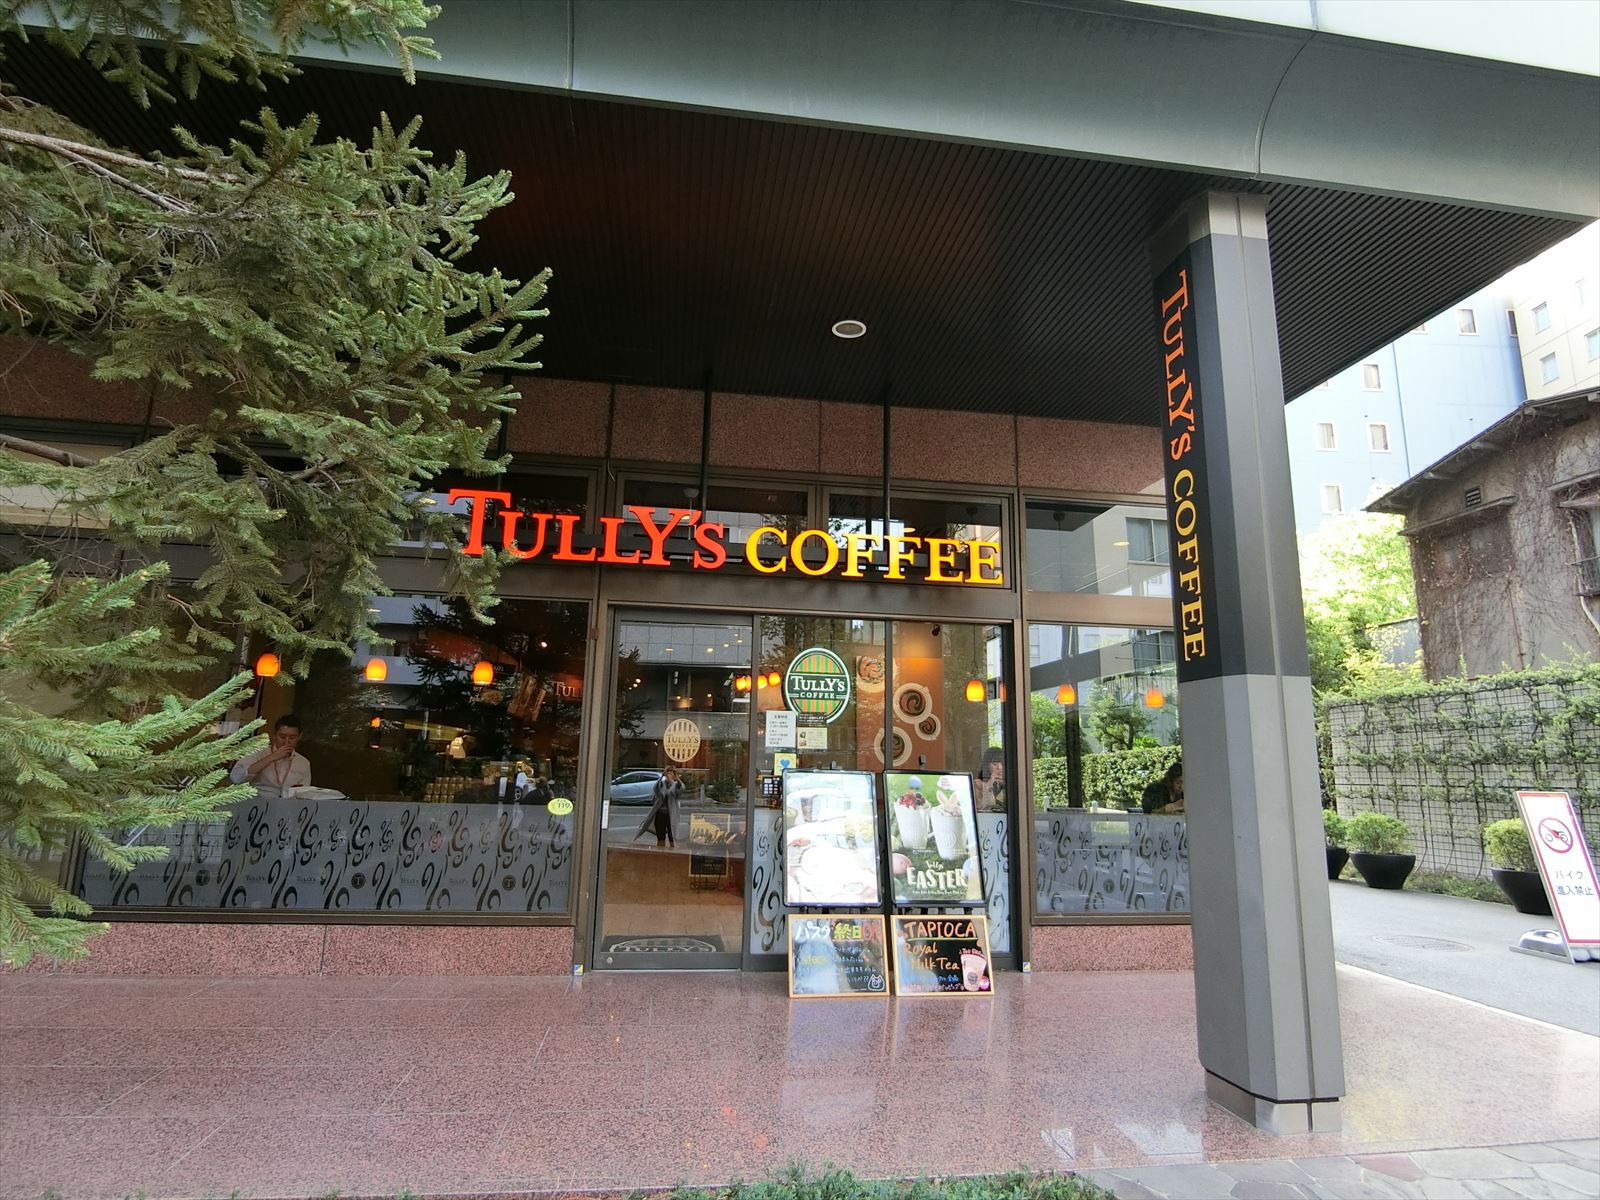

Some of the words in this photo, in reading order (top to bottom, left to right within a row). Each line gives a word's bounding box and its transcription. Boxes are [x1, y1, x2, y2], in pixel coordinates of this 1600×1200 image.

[1161, 269, 1195, 461] TULLY'S
[448, 487, 727, 569] TULLY'S
[745, 526, 1005, 585] COFFEE
[1172, 468, 1207, 662] COFFEE
[790, 675, 846, 692] TULLY'S
[906, 867, 969, 890] EASTER
[1555, 869, 1584, 880] バイク
[1556, 885, 1595, 896] 進入禁止
[903, 920, 977, 938] TAPIOCA
[902, 941, 938, 957] Royal
[936, 957, 961, 971] Tea
